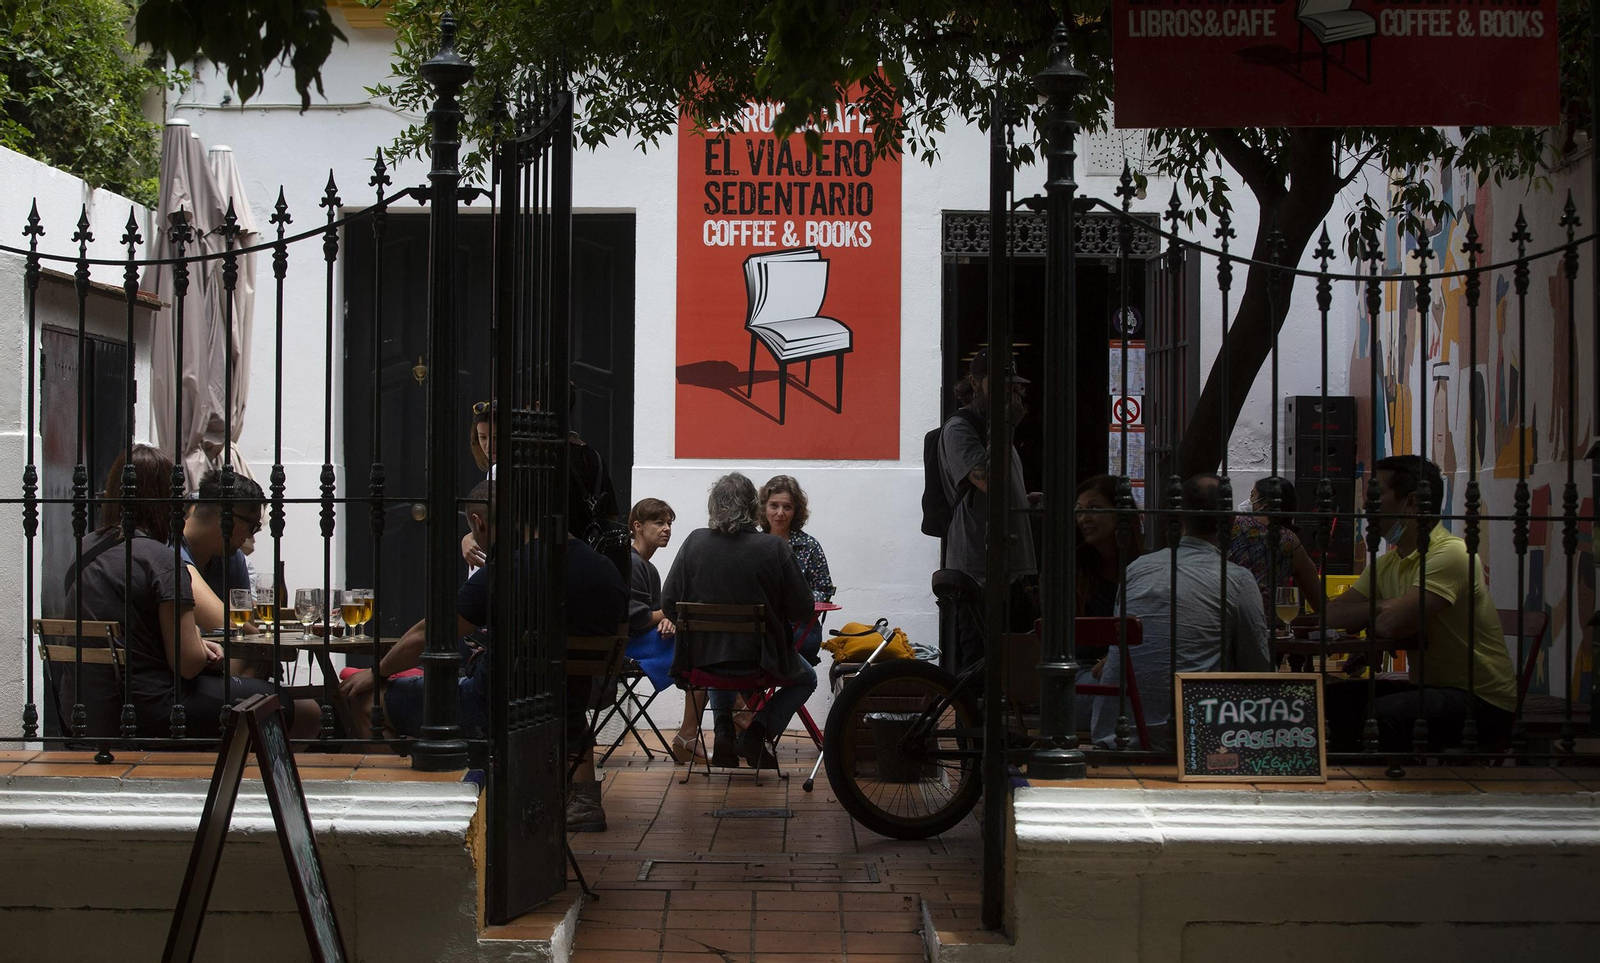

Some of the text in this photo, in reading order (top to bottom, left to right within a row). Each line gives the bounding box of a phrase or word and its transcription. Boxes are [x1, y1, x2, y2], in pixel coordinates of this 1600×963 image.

[1127, 8, 1277, 38] LIBROS&CAFE
[1379, 8, 1545, 39] COFFEE & BOOKS
[704, 138, 873, 177] EL VIAJERO
[703, 180, 874, 217] SEDENTARIO
[703, 219, 873, 248] COFFEE & BOOKS
[1198, 697, 1305, 725] TARTAS
[1221, 727, 1316, 749] CASERAS
[1250, 751, 1314, 773] VEGANAS
